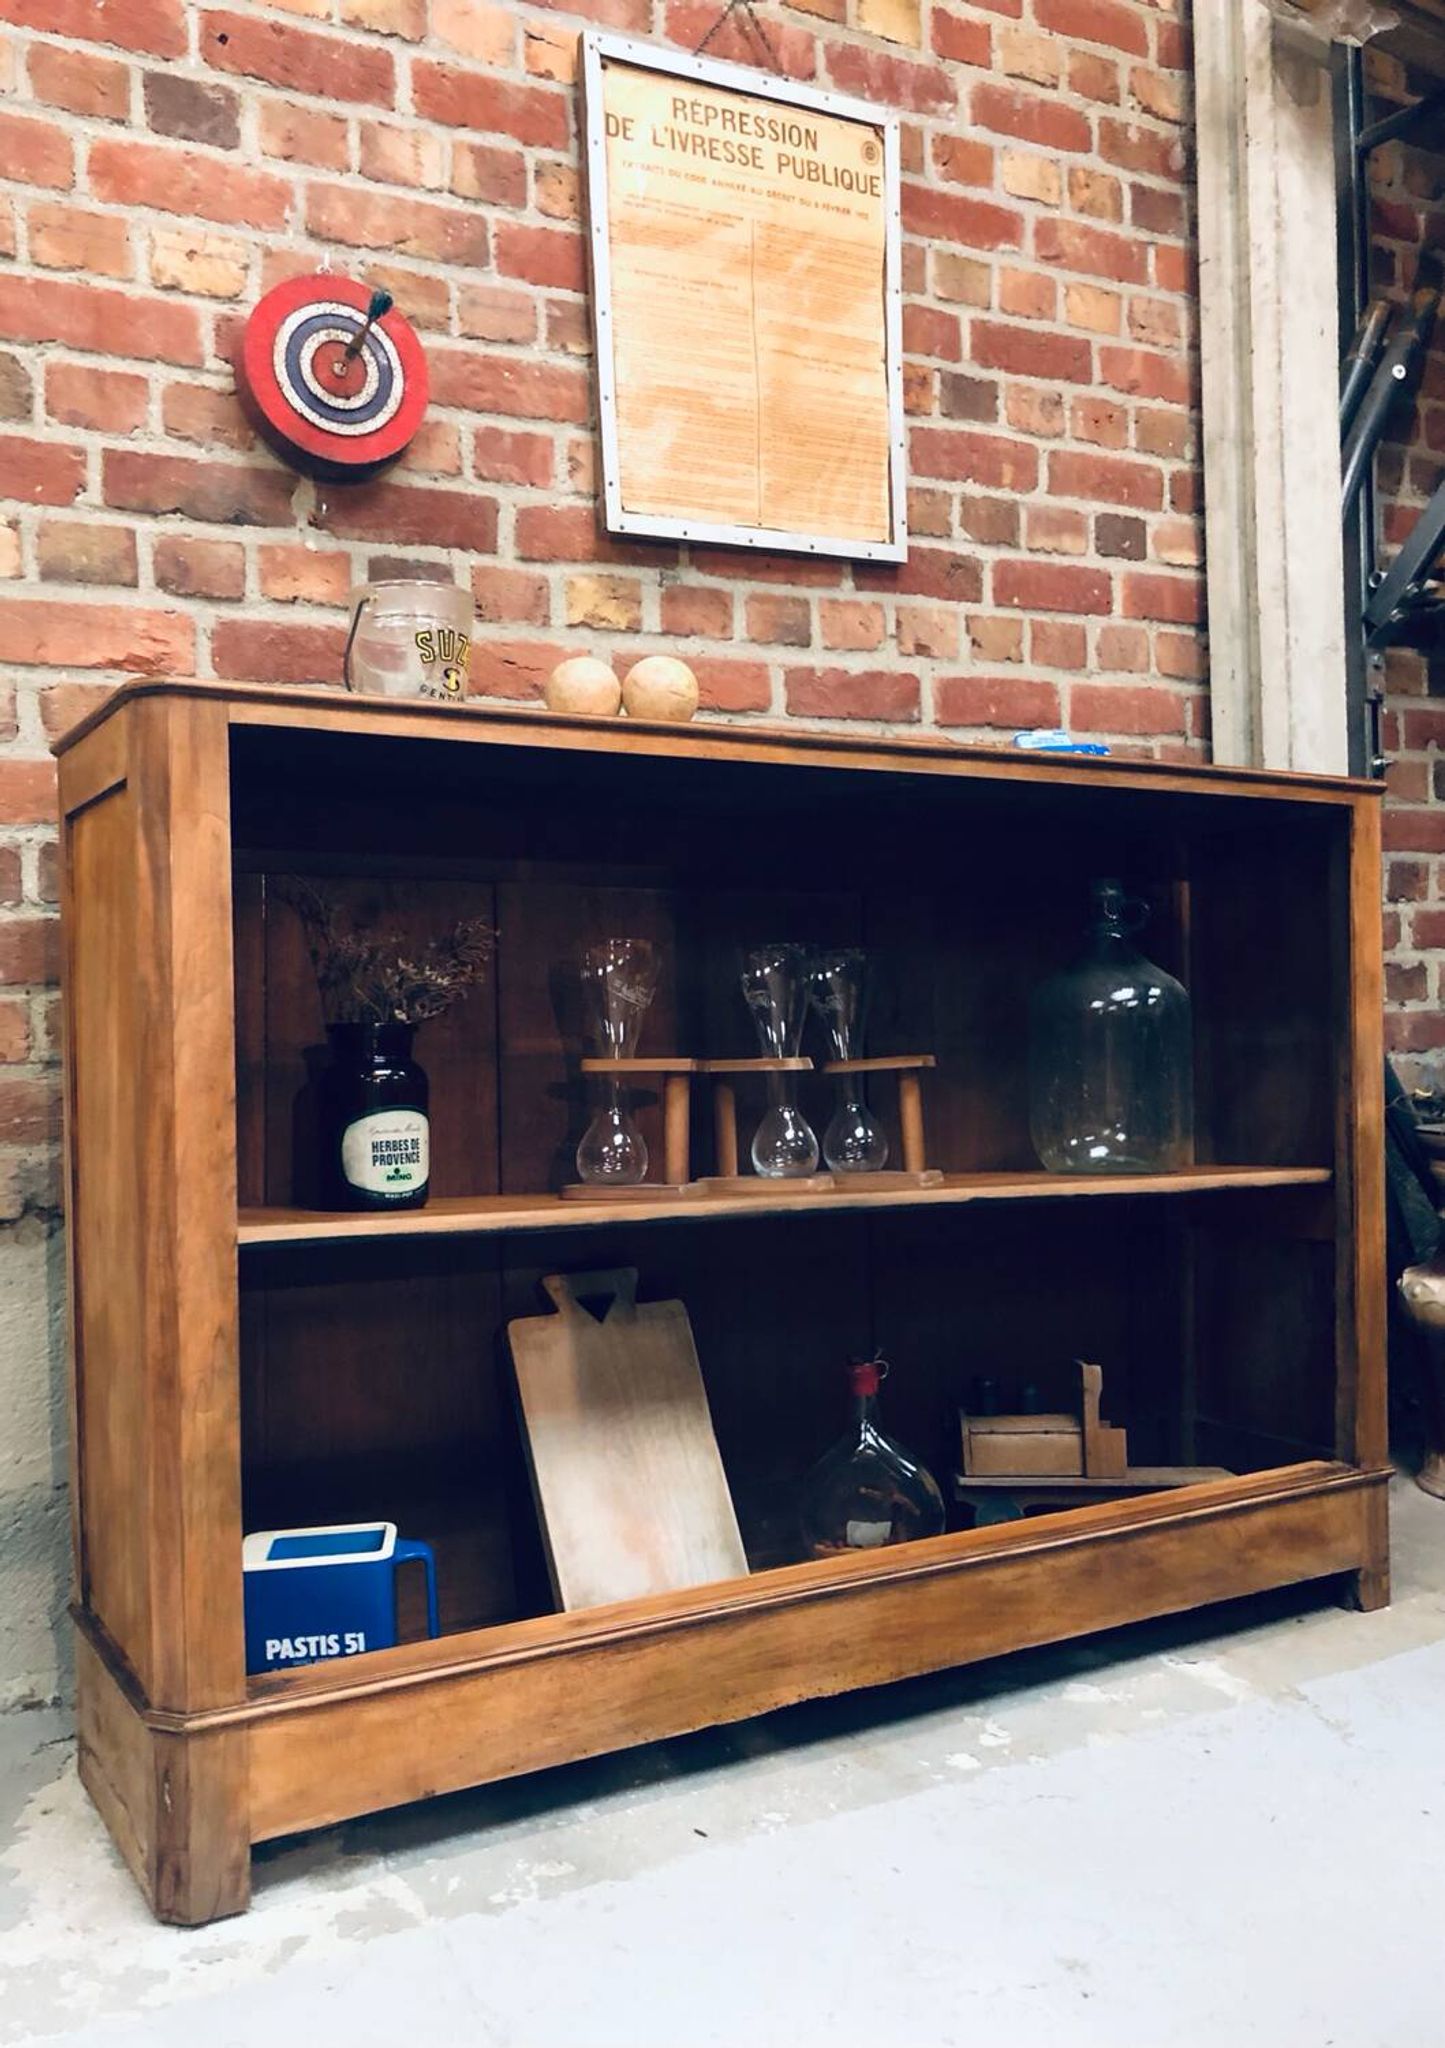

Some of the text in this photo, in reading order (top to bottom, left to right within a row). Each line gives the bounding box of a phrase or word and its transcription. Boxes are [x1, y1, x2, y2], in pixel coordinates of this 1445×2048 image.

[672, 97, 818, 152] RÉPRESSION
[605, 112, 635, 142] DE
[652, 124, 765, 171] L'IVRESSE
[777, 152, 882, 198] PUBLIQUE
[371, 1138, 420, 1153] HERBES DE
[372, 1152, 420, 1167] PROVENCE
[265, 1631, 366, 1660] PASTIS 51
